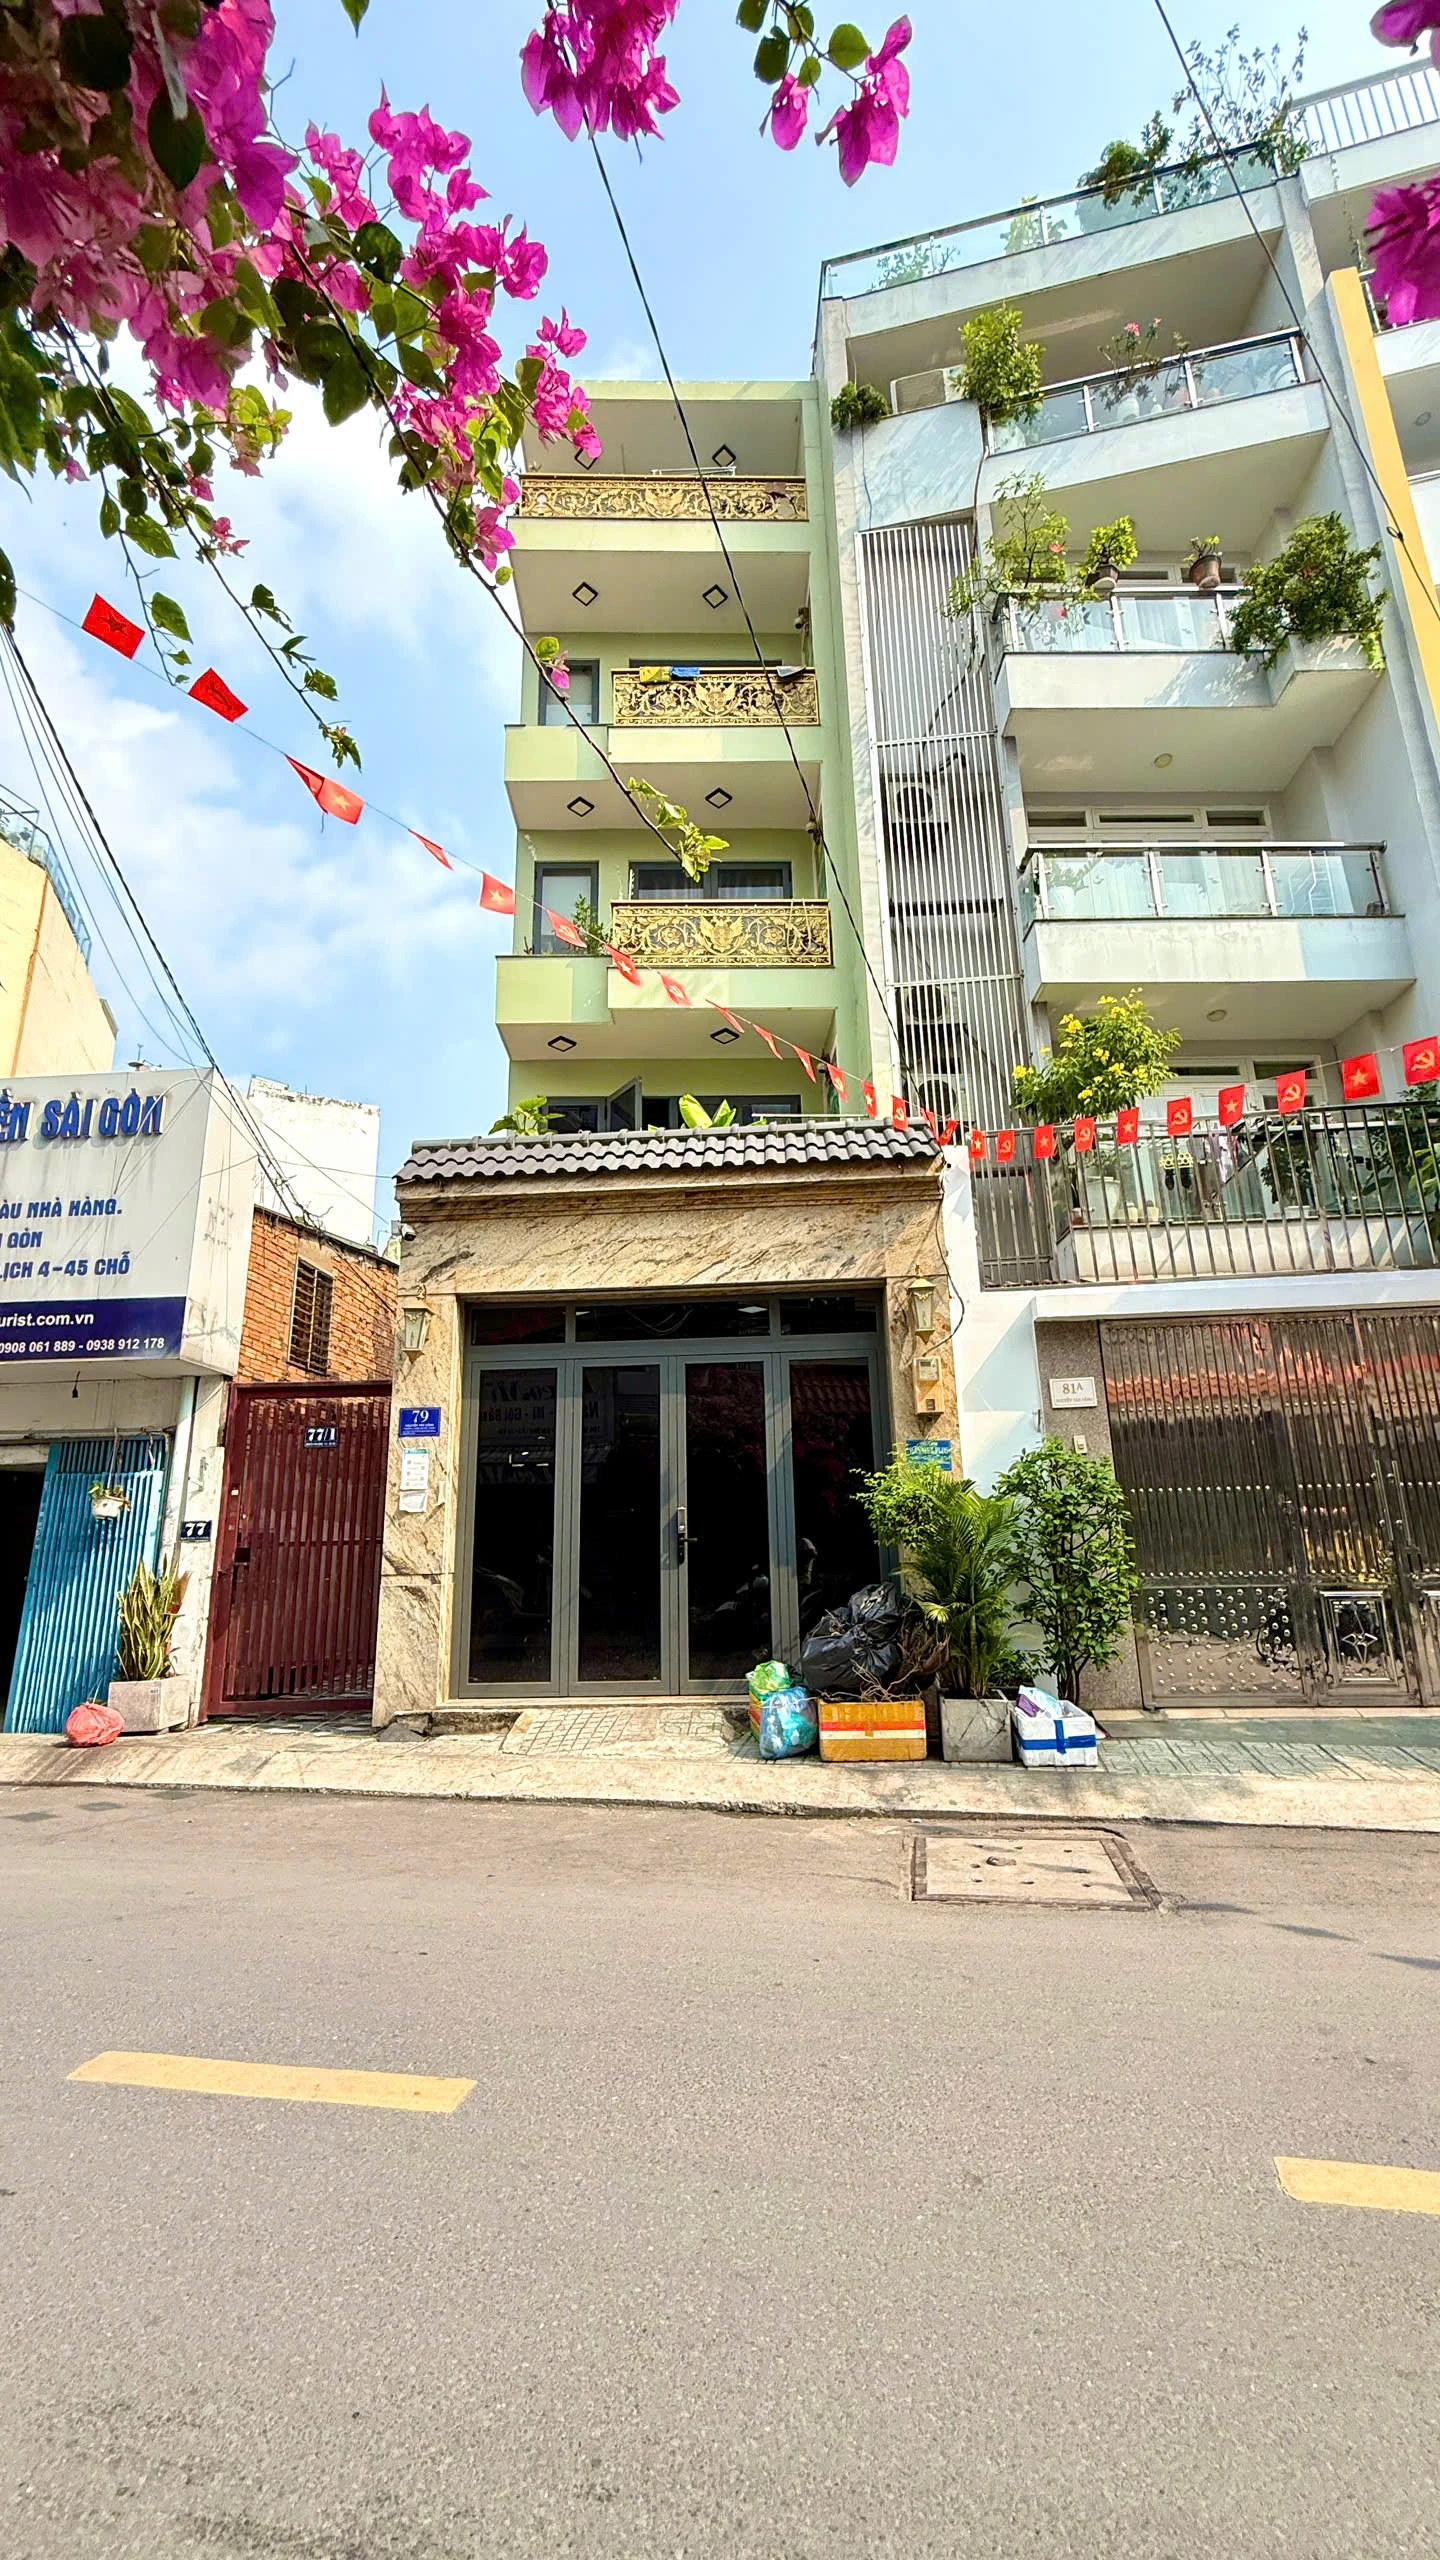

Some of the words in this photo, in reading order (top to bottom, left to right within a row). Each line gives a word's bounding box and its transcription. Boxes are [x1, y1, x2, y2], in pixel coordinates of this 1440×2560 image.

[41, 1092, 95, 1138] SÀI
[98, 1088, 165, 1137] GÒN
[27, 1197, 62, 1218] NHÀ
[68, 1196, 122, 1216] HÀNG.
[94, 1251, 130, 1275] CHỖ
[0, 1313, 94, 1327] urist.com.vn
[29, 1341, 50, 1352] 061
[54, 1340, 75, 1352] 889
[86, 1339, 114, 1351] 0938
[118, 1339, 139, 1350] 912
[143, 1338, 164, 1349] 178
[1062, 1382, 1083, 1394] 81A
[412, 1410, 429, 1423] 79
[307, 1428, 336, 1441] 77/1
[185, 1522, 207, 1536] 77
